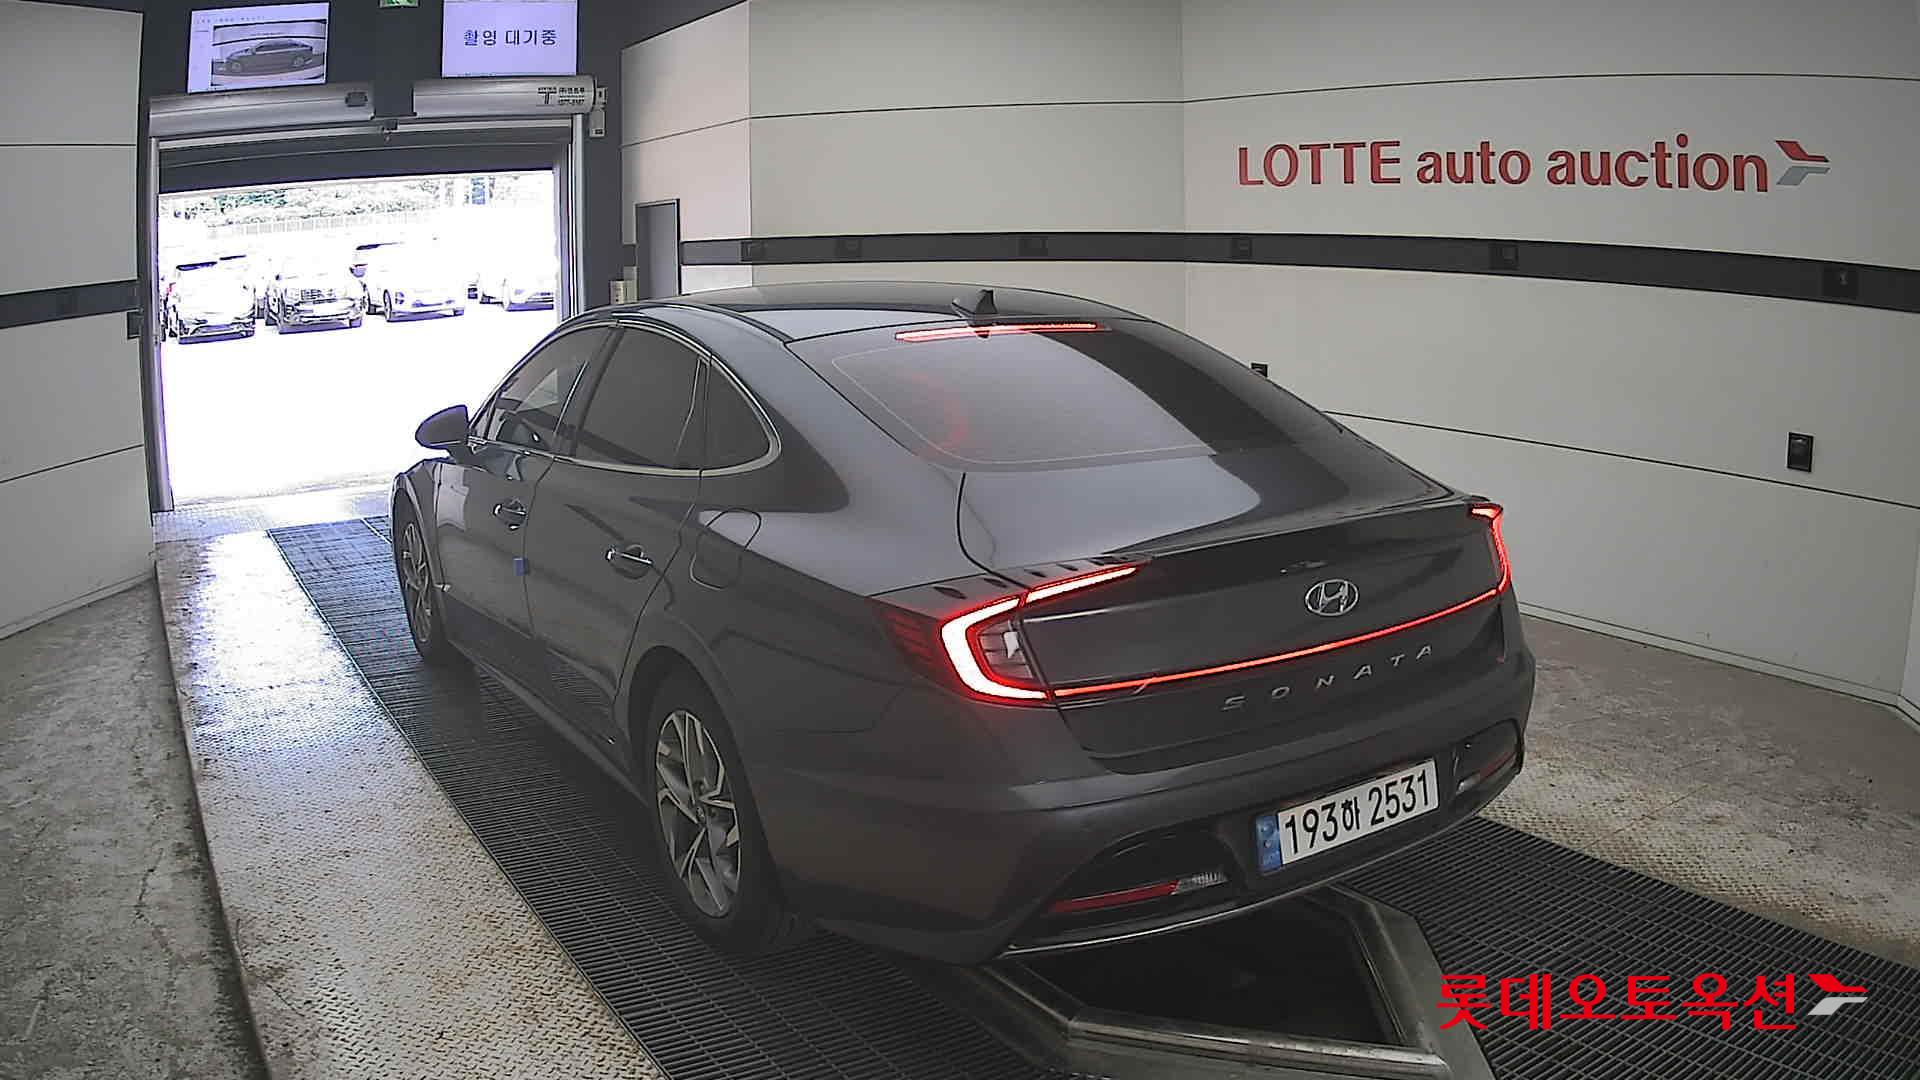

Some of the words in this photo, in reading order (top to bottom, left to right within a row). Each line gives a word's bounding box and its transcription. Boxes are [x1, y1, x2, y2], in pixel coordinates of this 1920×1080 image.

[505, 29, 557, 46] 대기중
[1238, 140, 1401, 187] LOTTE
[1416, 140, 1531, 186] auto
[1546, 133, 1768, 193] auction
[1222, 645, 1432, 710] SONATA
[1284, 797, 1360, 855] 193하
[1368, 769, 1430, 827] 2531
